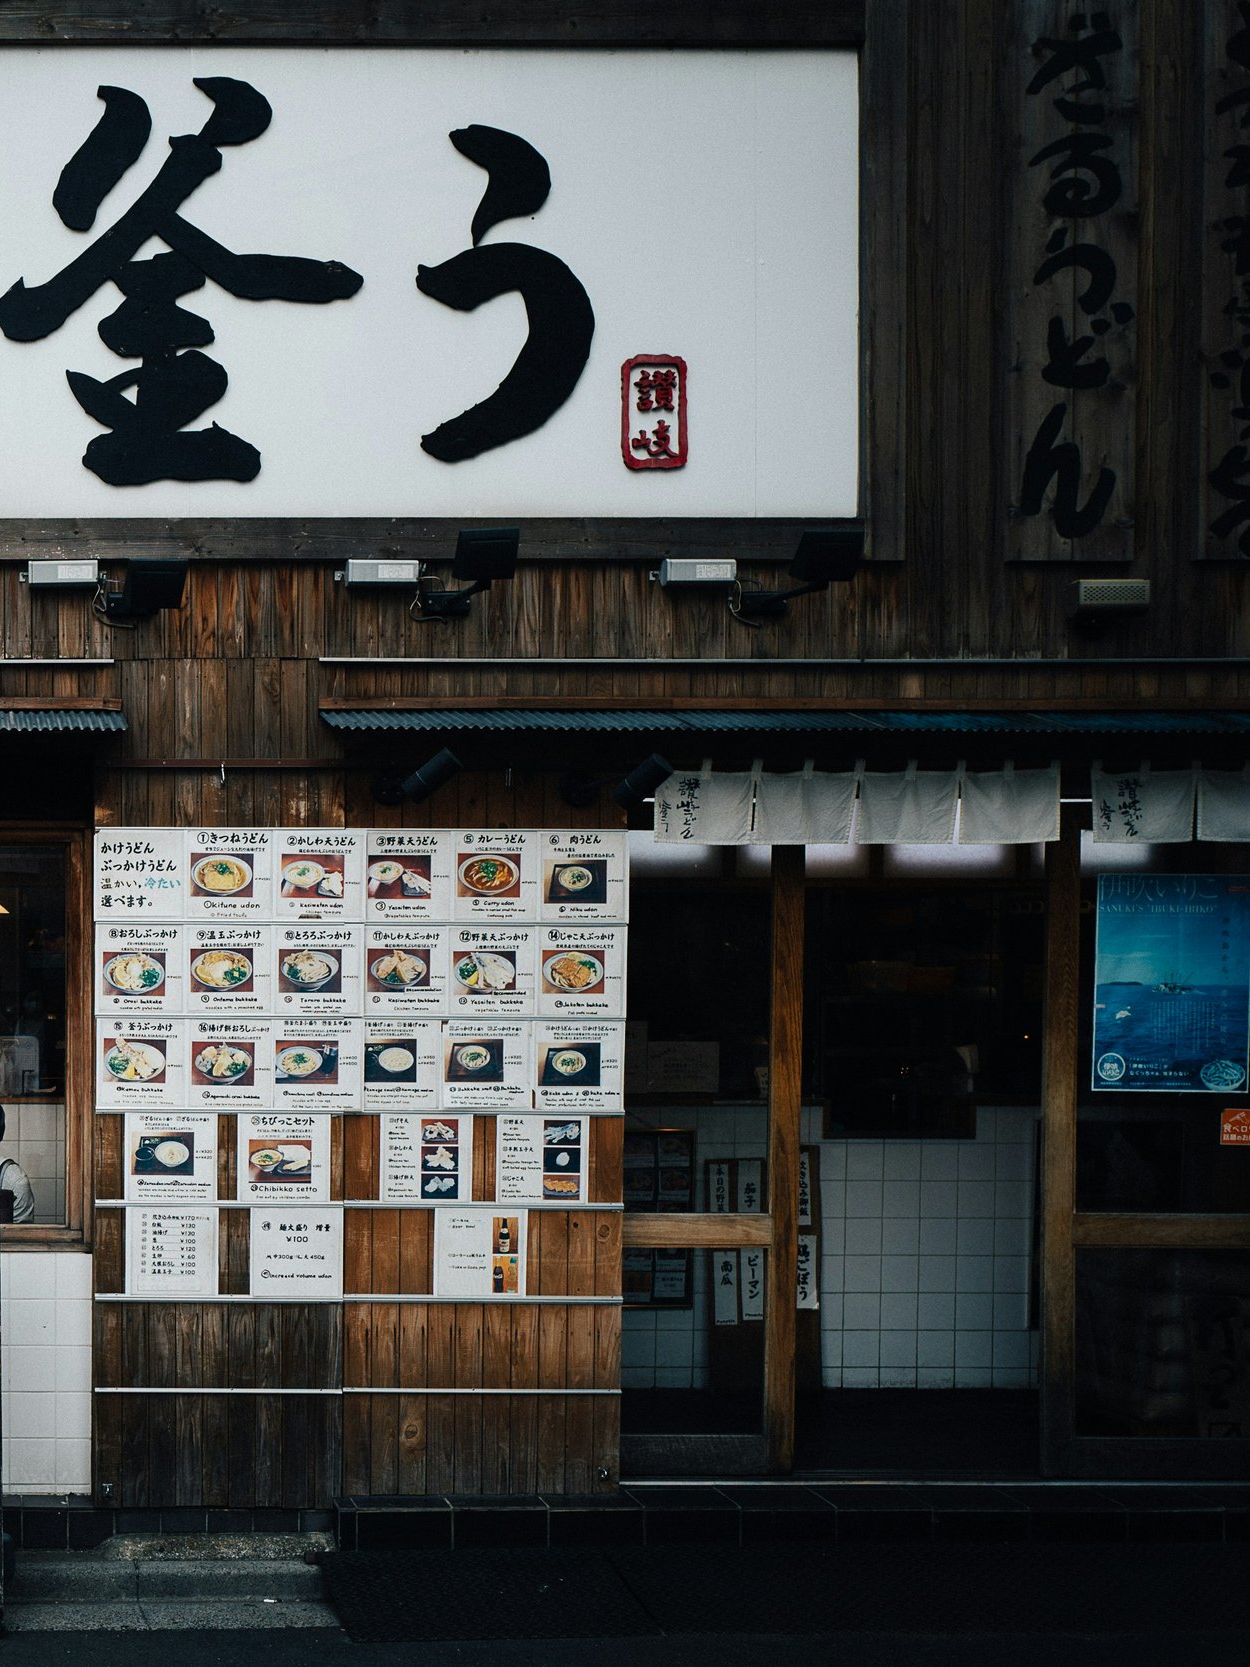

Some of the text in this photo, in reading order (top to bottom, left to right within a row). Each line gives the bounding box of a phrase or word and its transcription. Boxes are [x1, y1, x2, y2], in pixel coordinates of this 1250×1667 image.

[1020, 12, 1135, 539] ざるうどん
[477, 834, 527, 845] カレーうどん
[569, 834, 602, 845] 肉うどん
[100, 842, 155, 855] かけうどん
[100, 859, 178, 873] ぶっかけうどん
[100, 894, 153, 908] 選べます。
[240, 901, 261, 909] udon
[128, 1022, 173, 1032] 釜うぶっかけ
[1224, 1122, 1250, 1133] 食べロ
[286, 1235, 309, 1243] ¥100
